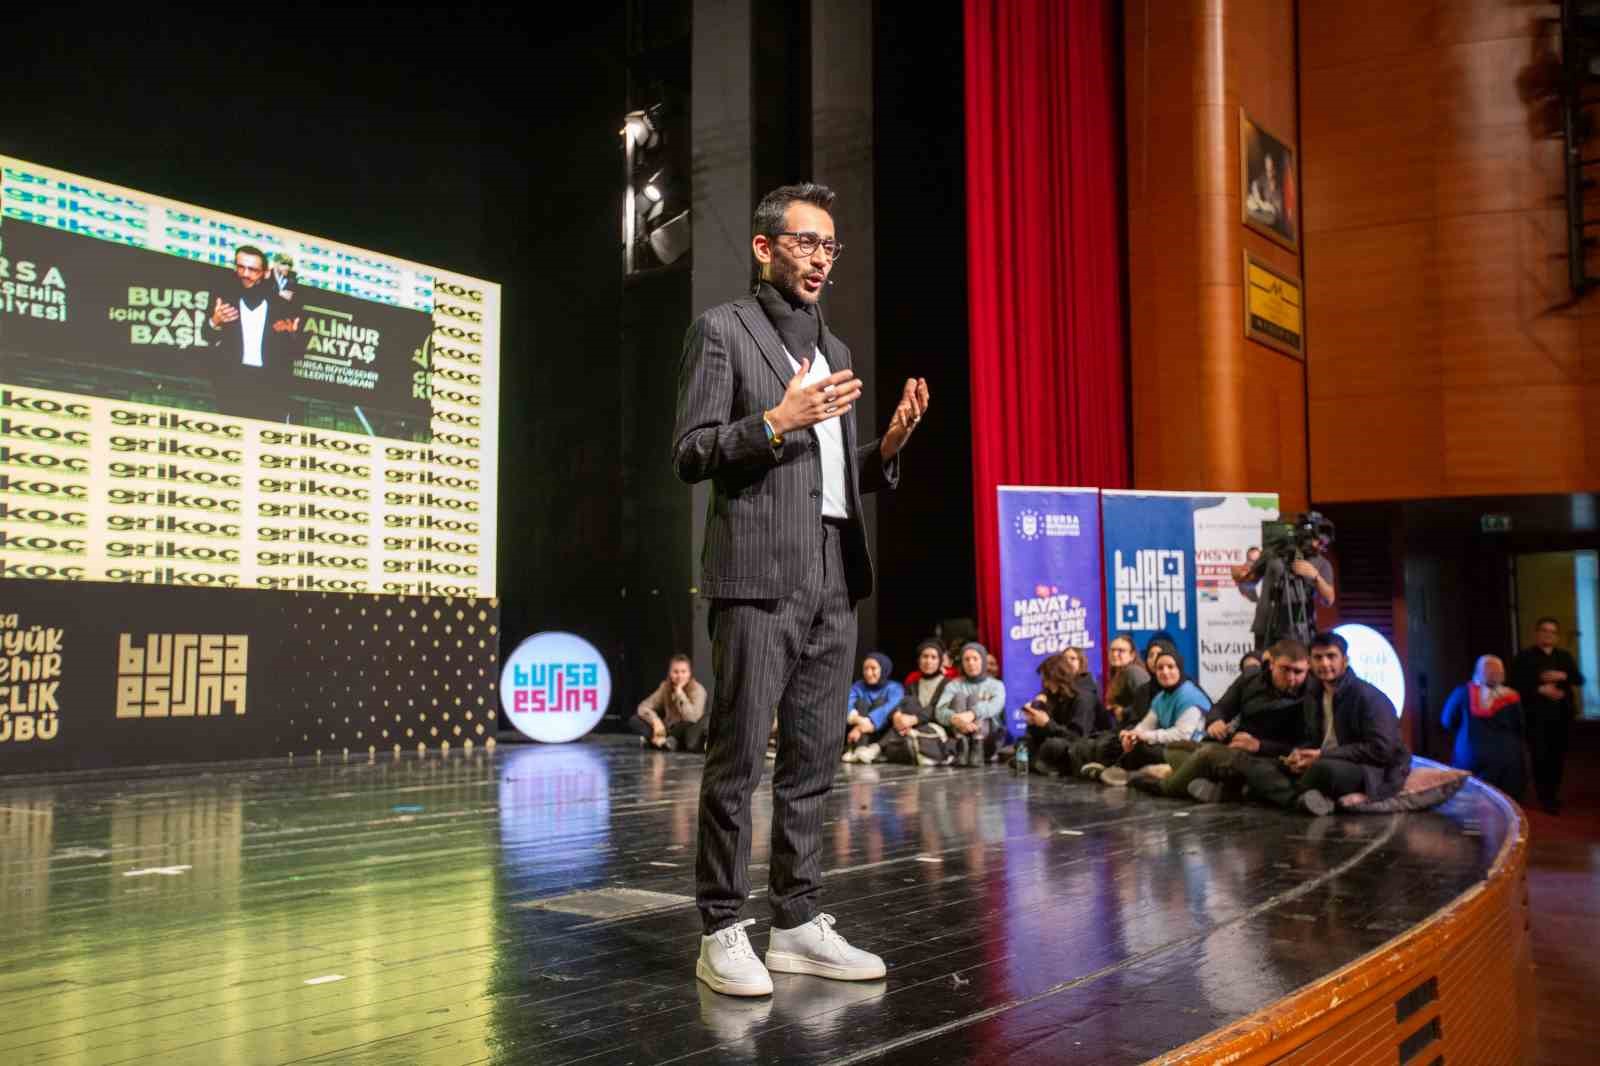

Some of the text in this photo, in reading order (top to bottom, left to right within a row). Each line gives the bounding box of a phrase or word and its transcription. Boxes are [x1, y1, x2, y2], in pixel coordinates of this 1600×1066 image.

[128, 286, 209, 310] BURS
[131, 324, 209, 349] BAŞL
[1014, 595, 1068, 616] HAYAT
